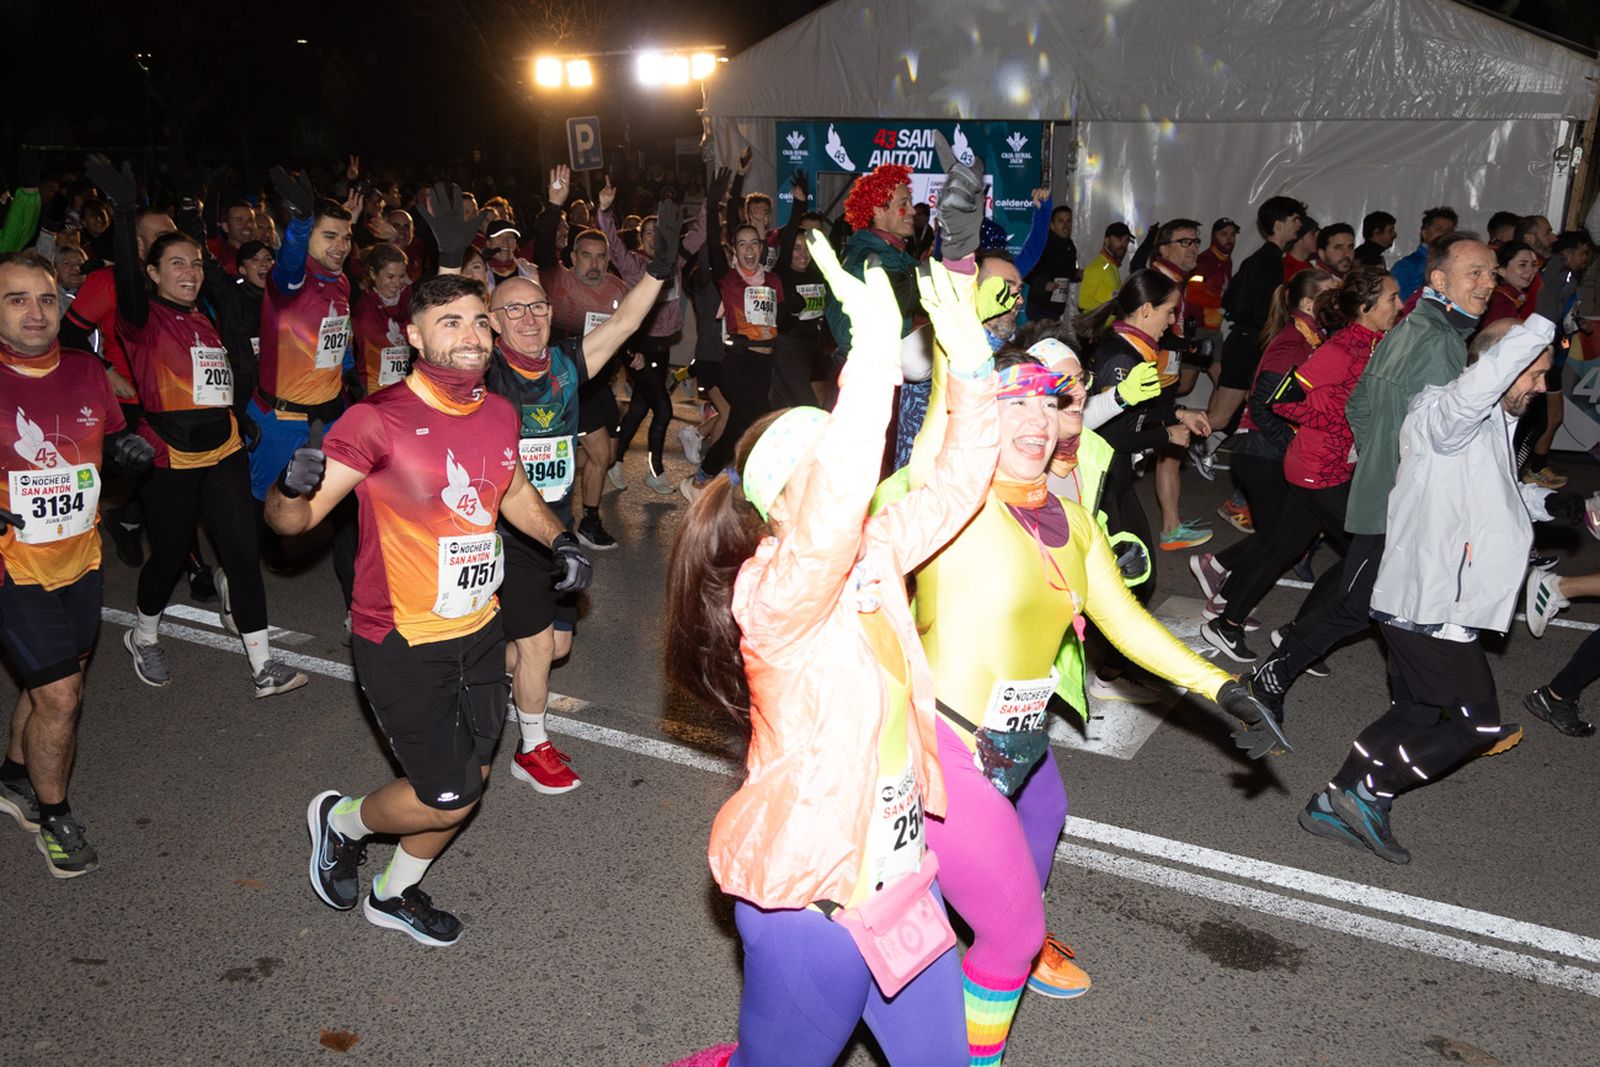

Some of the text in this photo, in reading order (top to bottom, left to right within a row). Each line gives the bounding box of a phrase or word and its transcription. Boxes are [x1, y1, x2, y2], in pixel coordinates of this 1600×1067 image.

[575, 123, 594, 164] P
[873, 128, 935, 149] 43 SAN
[834, 150, 846, 163] 43
[867, 145, 933, 169] ANTÓN
[960, 151, 974, 165] 43
[323, 332, 348, 350] 2021
[35, 447, 58, 468] 43
[32, 476, 59, 486] NOCHE
[61, 475, 71, 484] DE
[21, 488, 40, 496] SAN
[32, 492, 84, 518] 3134
[457, 494, 477, 516] 43
[459, 542, 492, 554] NOCHE DE
[449, 556, 466, 566] SAN
[457, 559, 497, 590] 4751
[1015, 690, 1042, 702] NOCHE
[999, 704, 1019, 715] SAN
